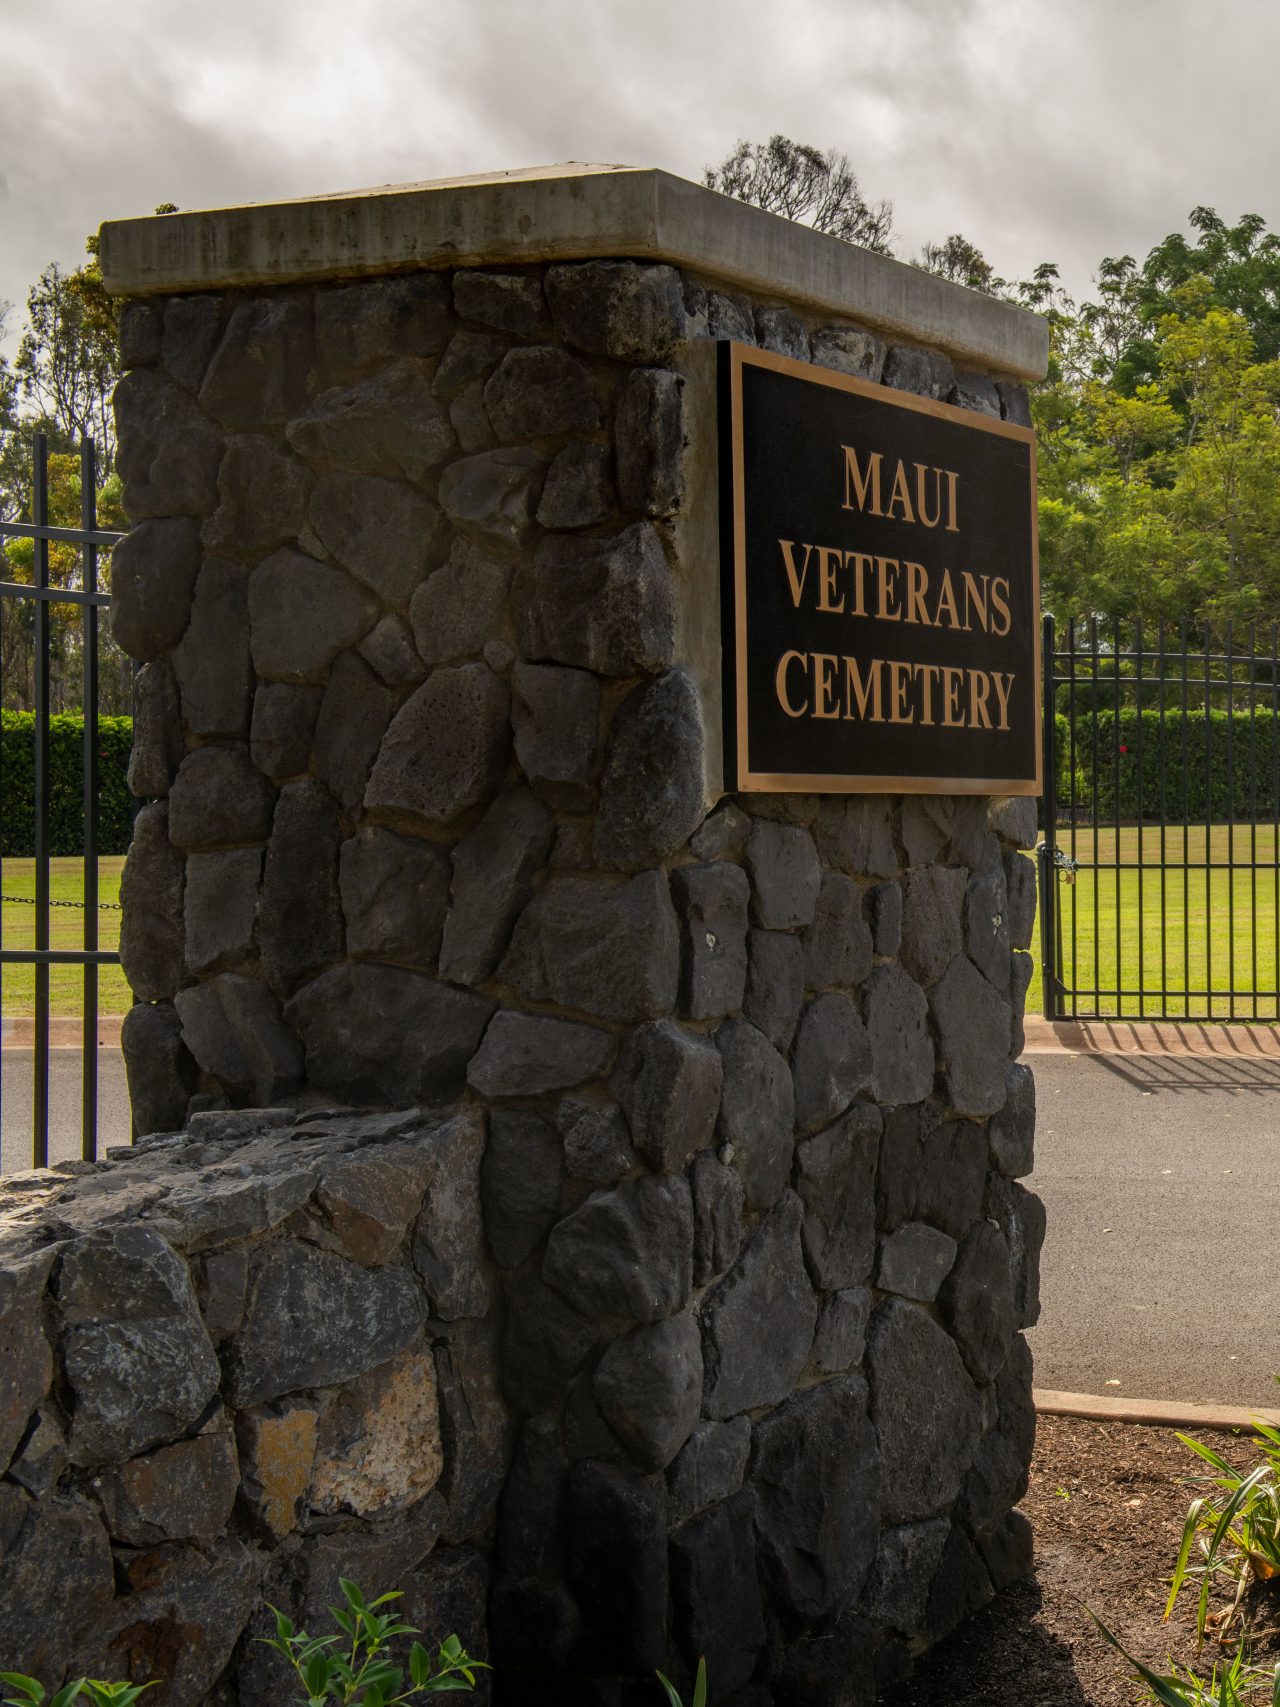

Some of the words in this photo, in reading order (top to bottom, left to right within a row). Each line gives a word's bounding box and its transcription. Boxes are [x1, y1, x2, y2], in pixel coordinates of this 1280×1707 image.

[840, 444, 960, 533] MAUI
[778, 539, 1012, 637] VETERANS
[775, 649, 1016, 731] CEMETERY
